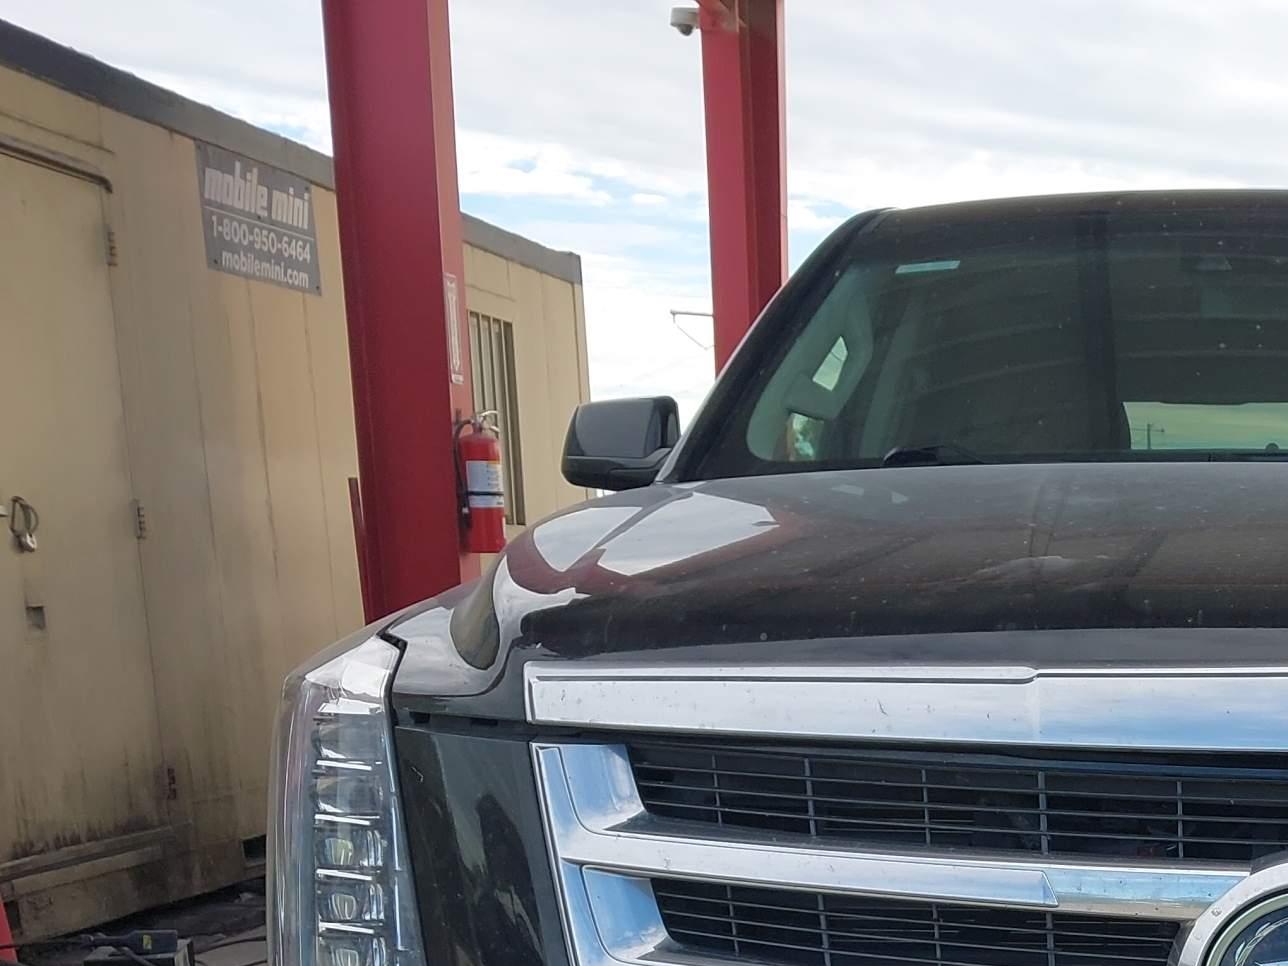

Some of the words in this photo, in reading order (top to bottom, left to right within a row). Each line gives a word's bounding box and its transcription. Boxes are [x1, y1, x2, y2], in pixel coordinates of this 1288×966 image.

[204, 160, 268, 217] mobile
[272, 187, 310, 229] mini
[212, 215, 311, 263] 1-800-950-6464
[222, 250, 309, 288] mobilemini.com
